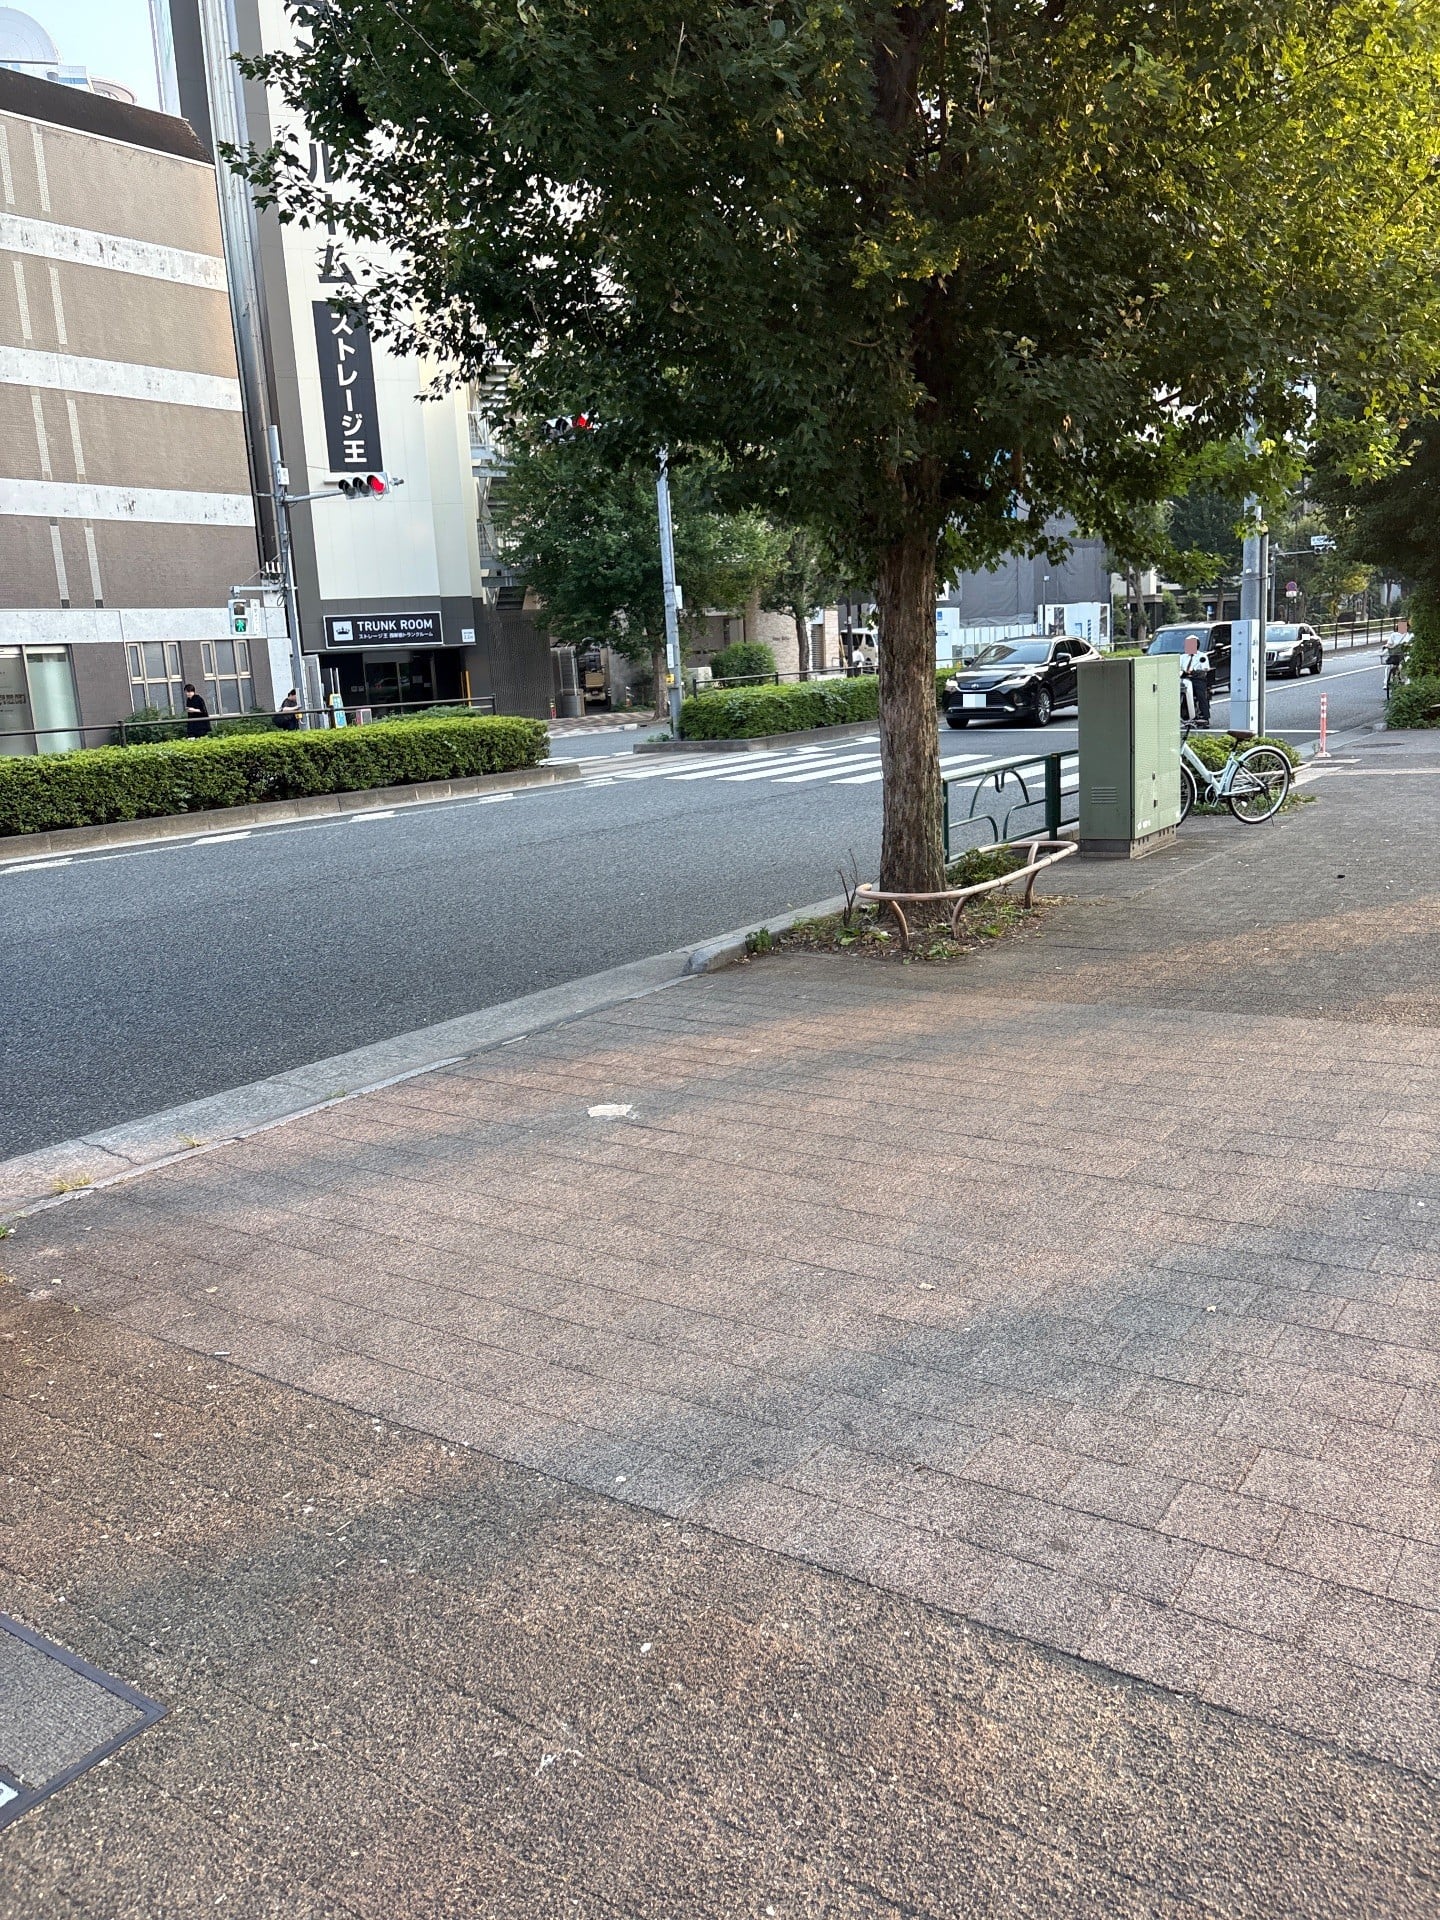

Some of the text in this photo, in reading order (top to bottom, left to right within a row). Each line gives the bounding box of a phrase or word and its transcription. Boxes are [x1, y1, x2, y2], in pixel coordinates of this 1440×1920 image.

[330, 312, 368, 463] ストレージ王
[357, 618, 433, 632] TRUNK ROOM
